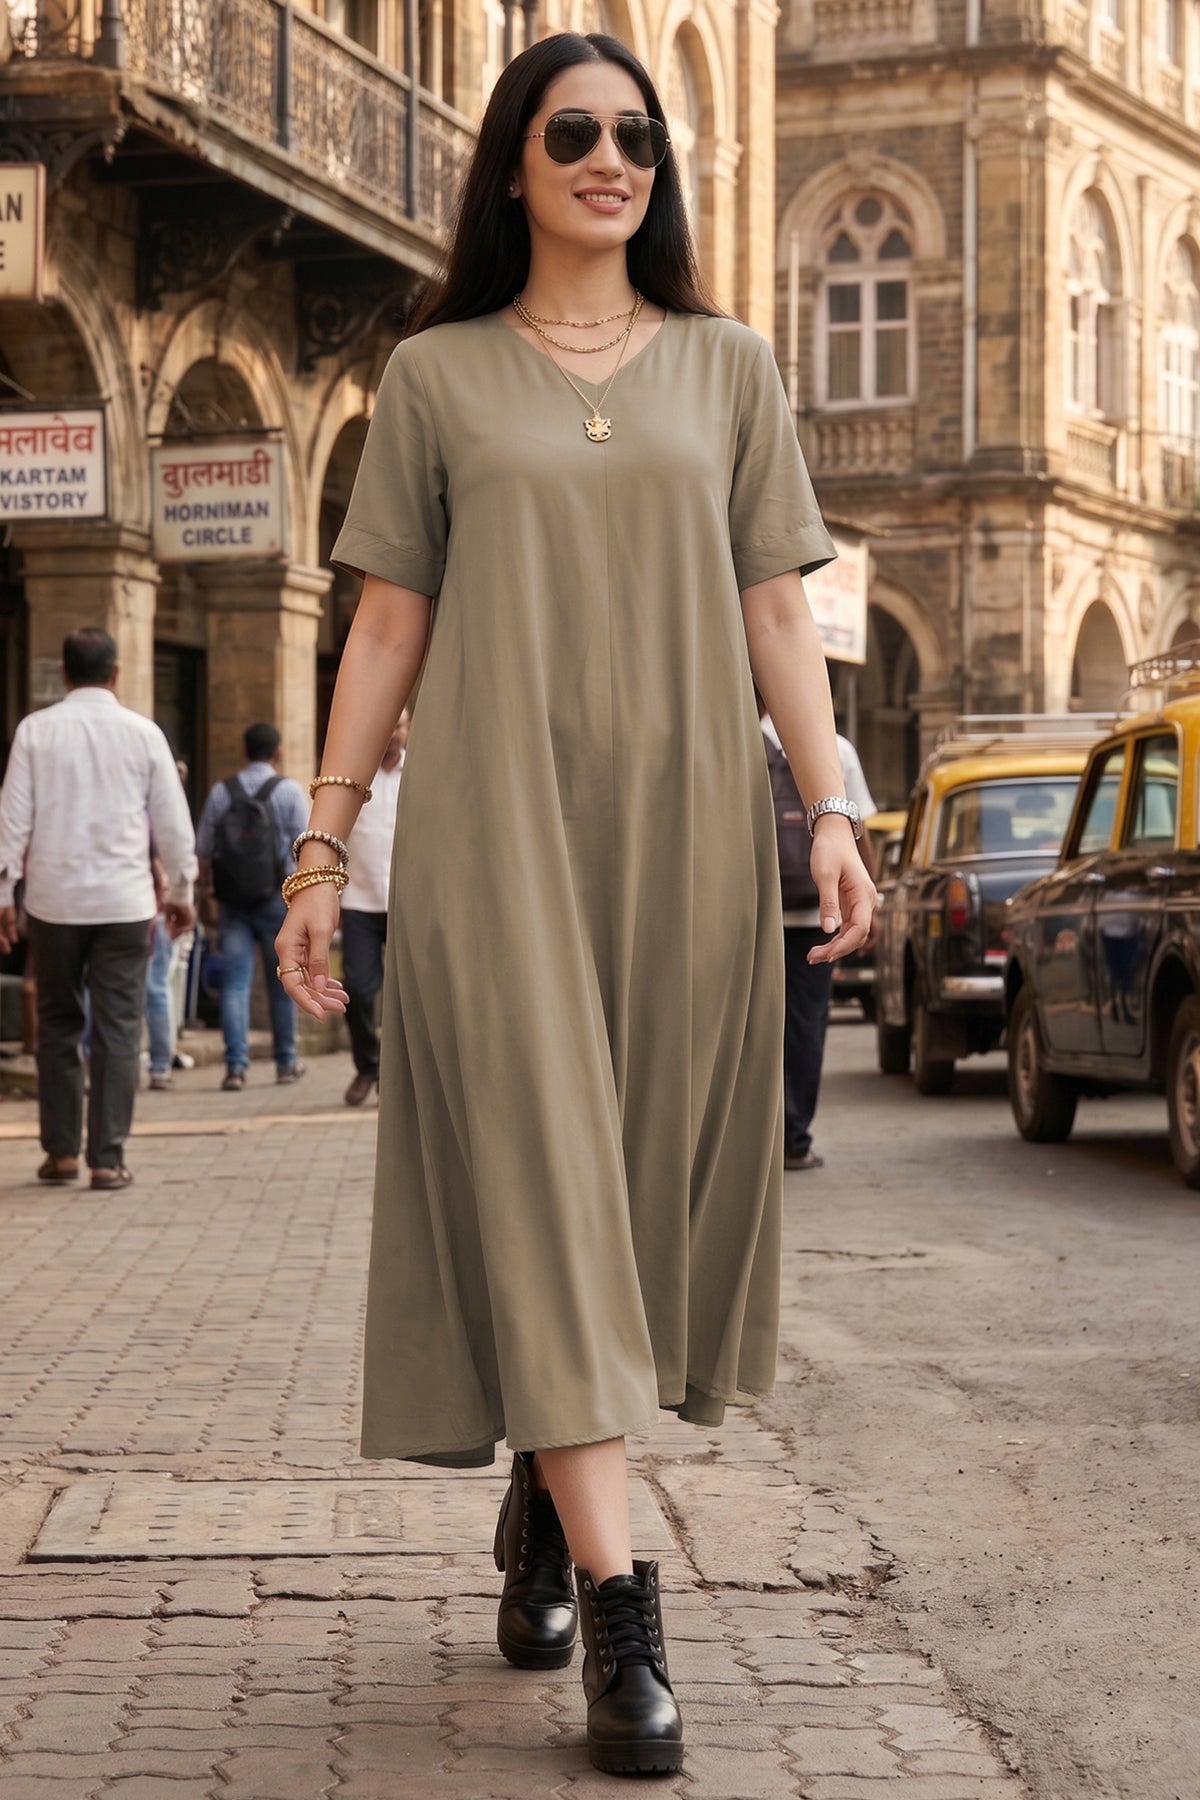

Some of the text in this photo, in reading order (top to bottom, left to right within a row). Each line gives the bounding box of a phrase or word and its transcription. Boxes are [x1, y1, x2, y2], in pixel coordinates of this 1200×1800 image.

[0, 466, 86, 485] KARTAM
[0, 492, 87, 511] VISTORY
[164, 501, 269, 522] HORNIMAN
[182, 526, 252, 546] CIRCLE
